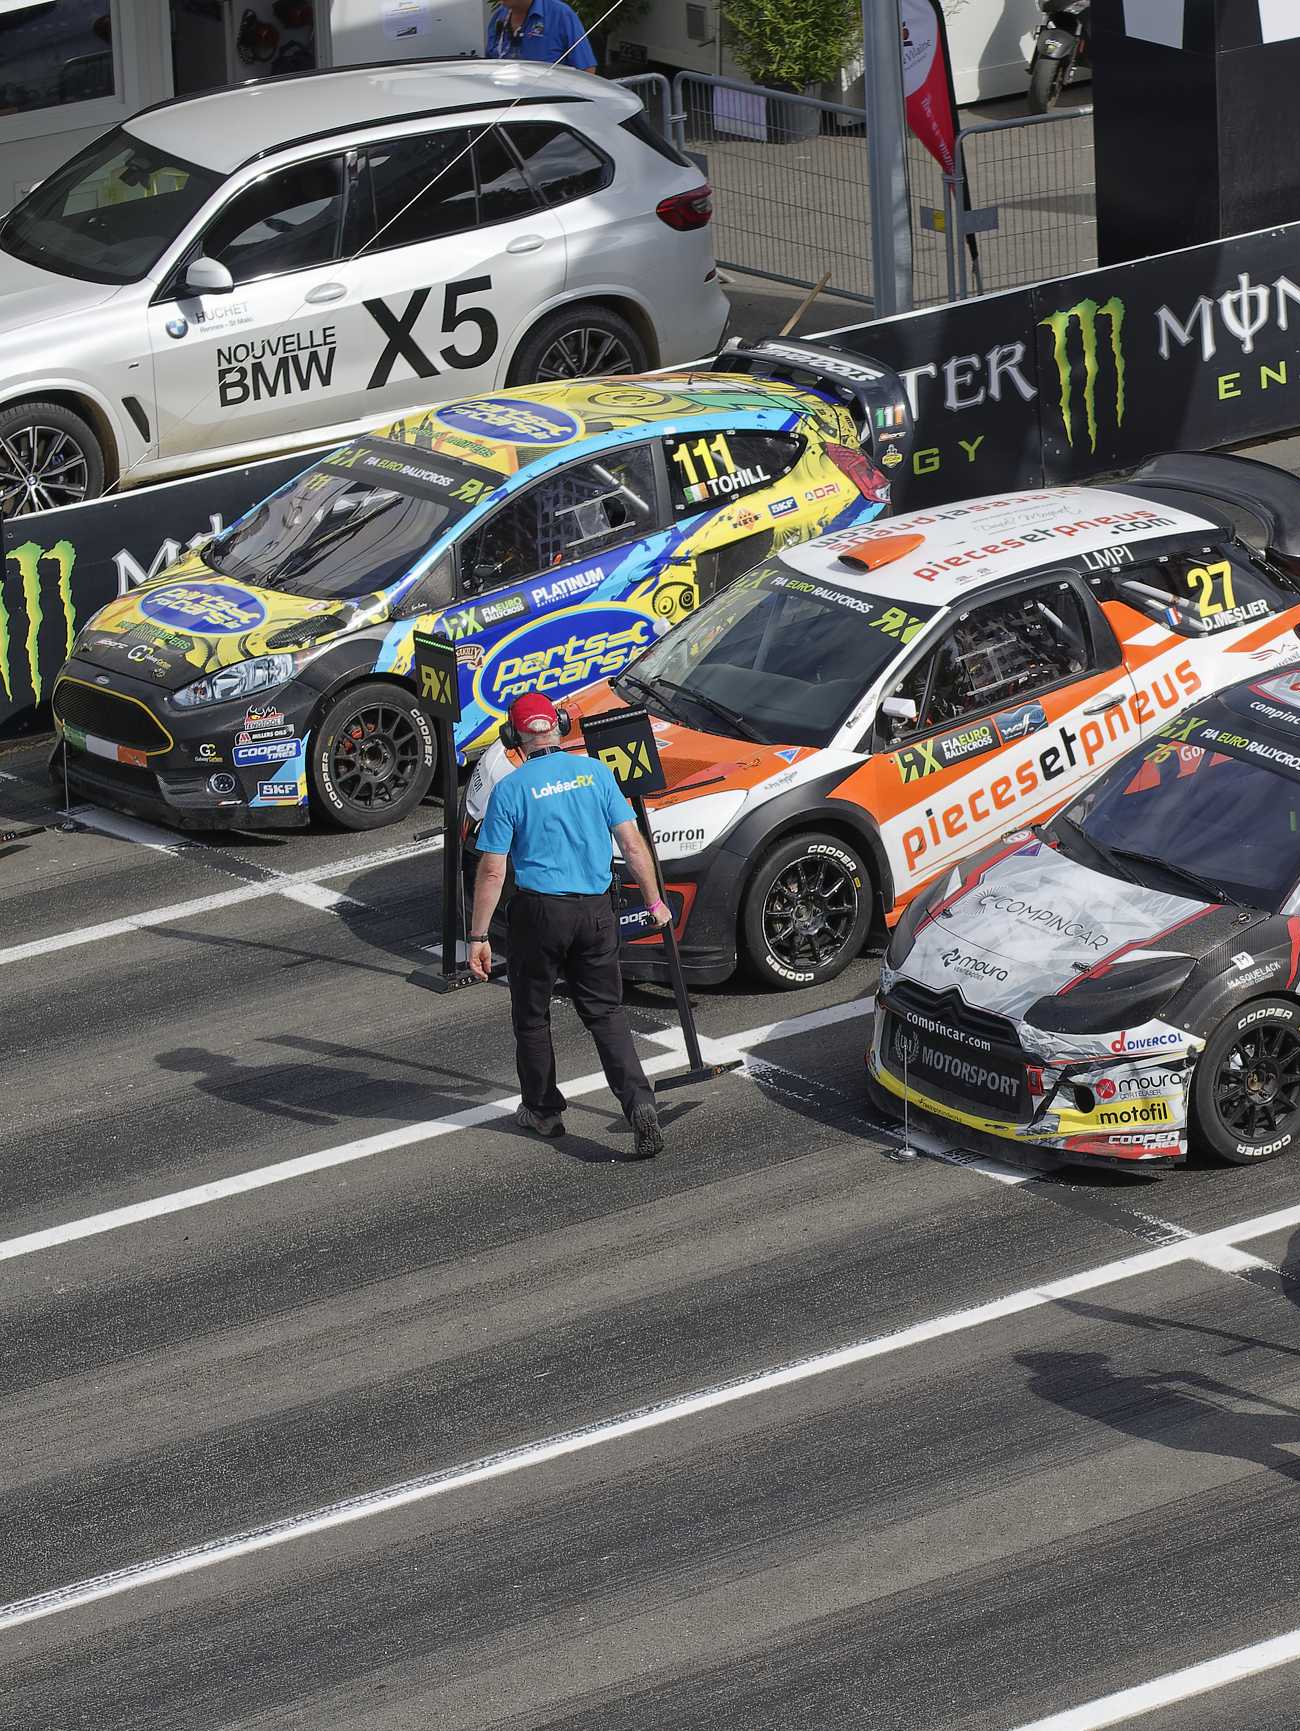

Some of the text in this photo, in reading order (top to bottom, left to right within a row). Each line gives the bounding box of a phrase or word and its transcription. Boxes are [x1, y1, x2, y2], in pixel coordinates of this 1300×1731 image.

[216, 326, 337, 367] NOUVELLE
[362, 275, 499, 390] X5
[218, 347, 337, 407] BMW
[672, 433, 737, 485] 111
[707, 465, 772, 497] TOHILL
[770, 500, 796, 514] SKF
[913, 510, 1158, 582] piecesetpneus
[1081, 545, 1135, 570] LMPI
[531, 567, 605, 604] PLATINUM
[770, 576, 787, 587] FIA
[786, 579, 816, 593] EURO
[810, 587, 874, 613] RALLYCROSS
[1186, 560, 1236, 617] 27
[1202, 599, 1270, 632] D.MESLIER
[492, 631, 610, 692] parts
[420, 664, 452, 705] RX
[238, 742, 297, 759] COOPER
[410, 708, 434, 767] COOPER
[944, 735, 993, 760] RALLYCROSS
[1200, 728, 1217, 741] FIA
[1216, 732, 1250, 749] EURO
[267, 750, 297, 761] TIRES
[597, 739, 653, 782] RX
[897, 739, 944, 783] RX
[902, 659, 1202, 872] piecesetpneus
[262, 783, 296, 795] SKF
[321, 752, 343, 809] COOPER
[531, 774, 594, 800] LohéacRX
[807, 844, 857, 872] COOPER
[766, 954, 815, 982] COOPER
[957, 955, 1009, 982] moura
[1226, 960, 1281, 989] MASQUELACK
[906, 1011, 992, 1051] compincar.com
[1237, 1008, 1293, 1030] COOPER
[1127, 1033, 1183, 1051] DIVERCOL
[922, 1046, 1020, 1097] MOTORSPORT
[1118, 1072, 1182, 1093] moura
[1100, 1103, 1168, 1124] motofil
[1108, 1131, 1180, 1145] COOPER
[1236, 1134, 1292, 1156] COOPER
